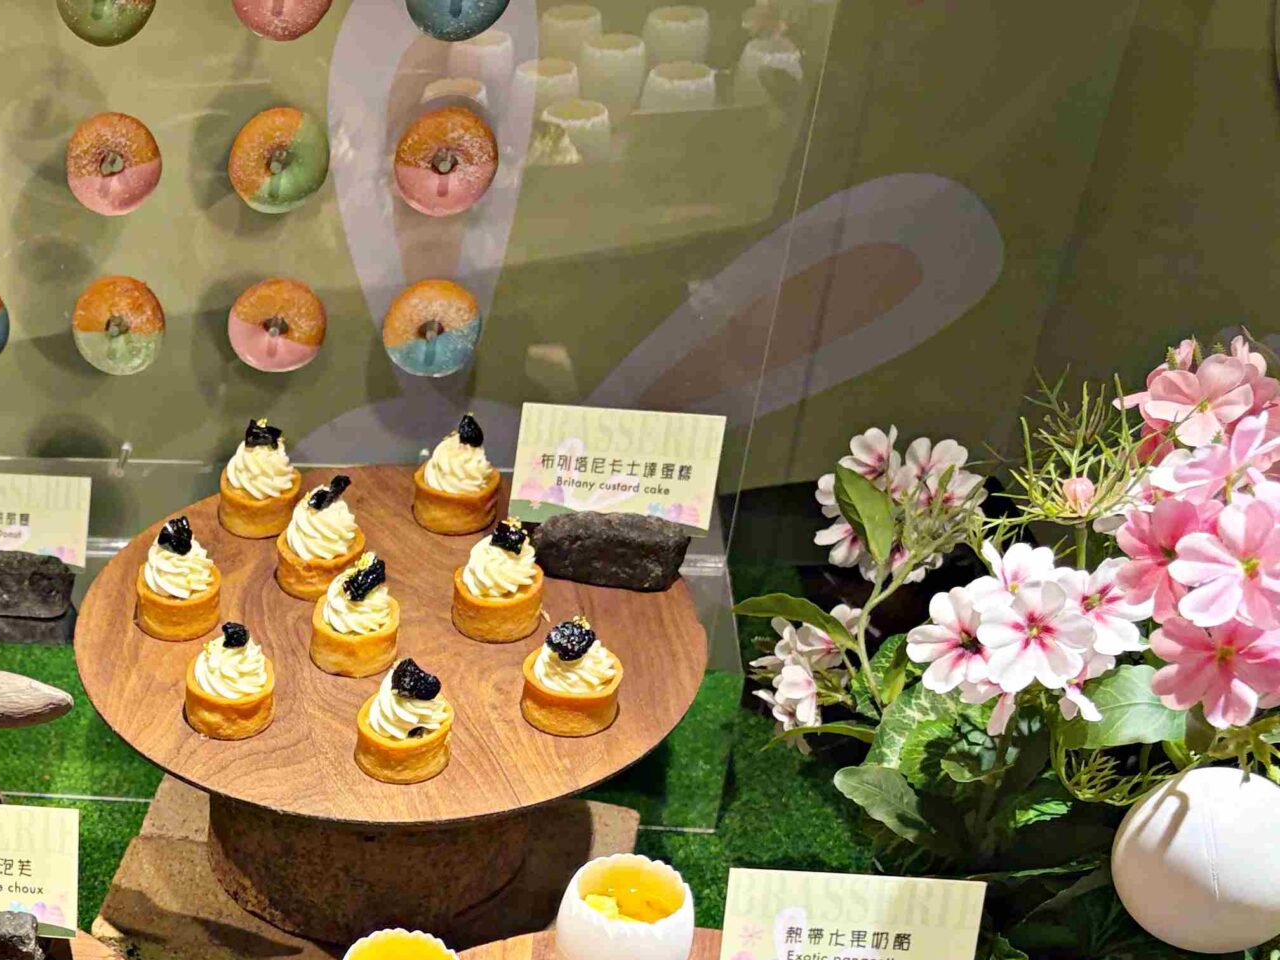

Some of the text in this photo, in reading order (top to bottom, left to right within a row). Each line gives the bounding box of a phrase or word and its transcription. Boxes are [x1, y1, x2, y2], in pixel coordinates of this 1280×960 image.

[540, 453, 694, 482] 布列塔尼卡士達蛋糕
[556, 475, 671, 496] Britany custard cake
[7, 882, 44, 895] choux
[785, 926, 912, 951] 熱帶水果奶酪
